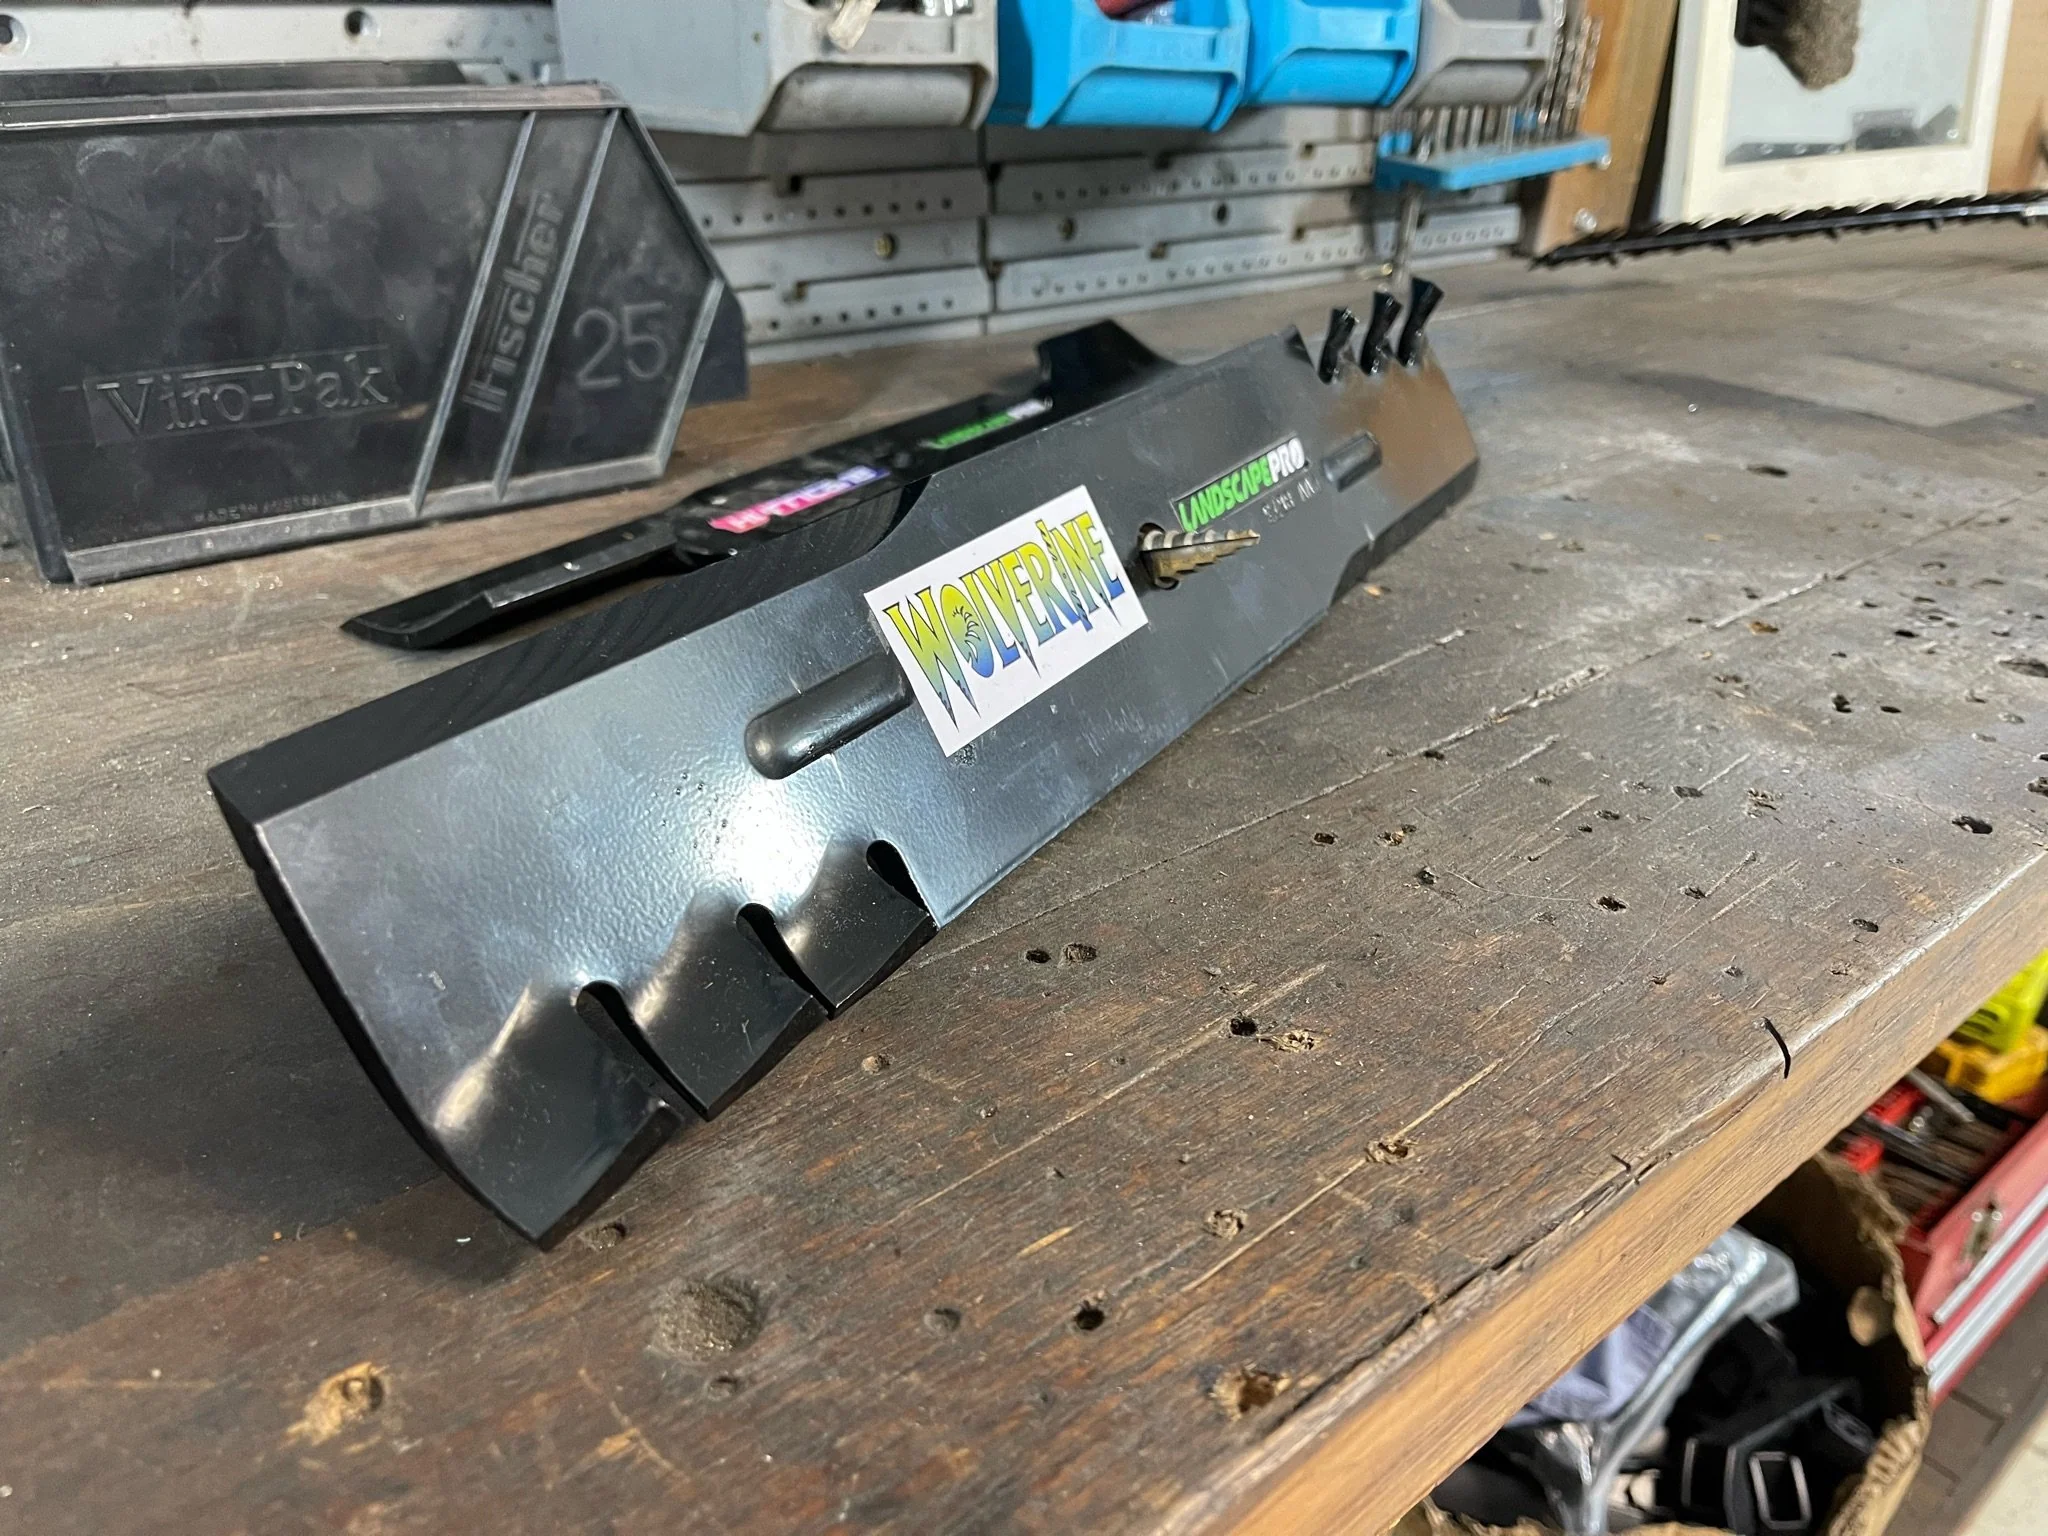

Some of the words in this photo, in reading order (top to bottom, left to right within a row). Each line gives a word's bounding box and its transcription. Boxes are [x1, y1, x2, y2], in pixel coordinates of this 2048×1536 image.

[572, 300, 669, 390] 25
[96, 351, 391, 432] Viro-Pak
[882, 511, 1126, 733] WOLVERINE
